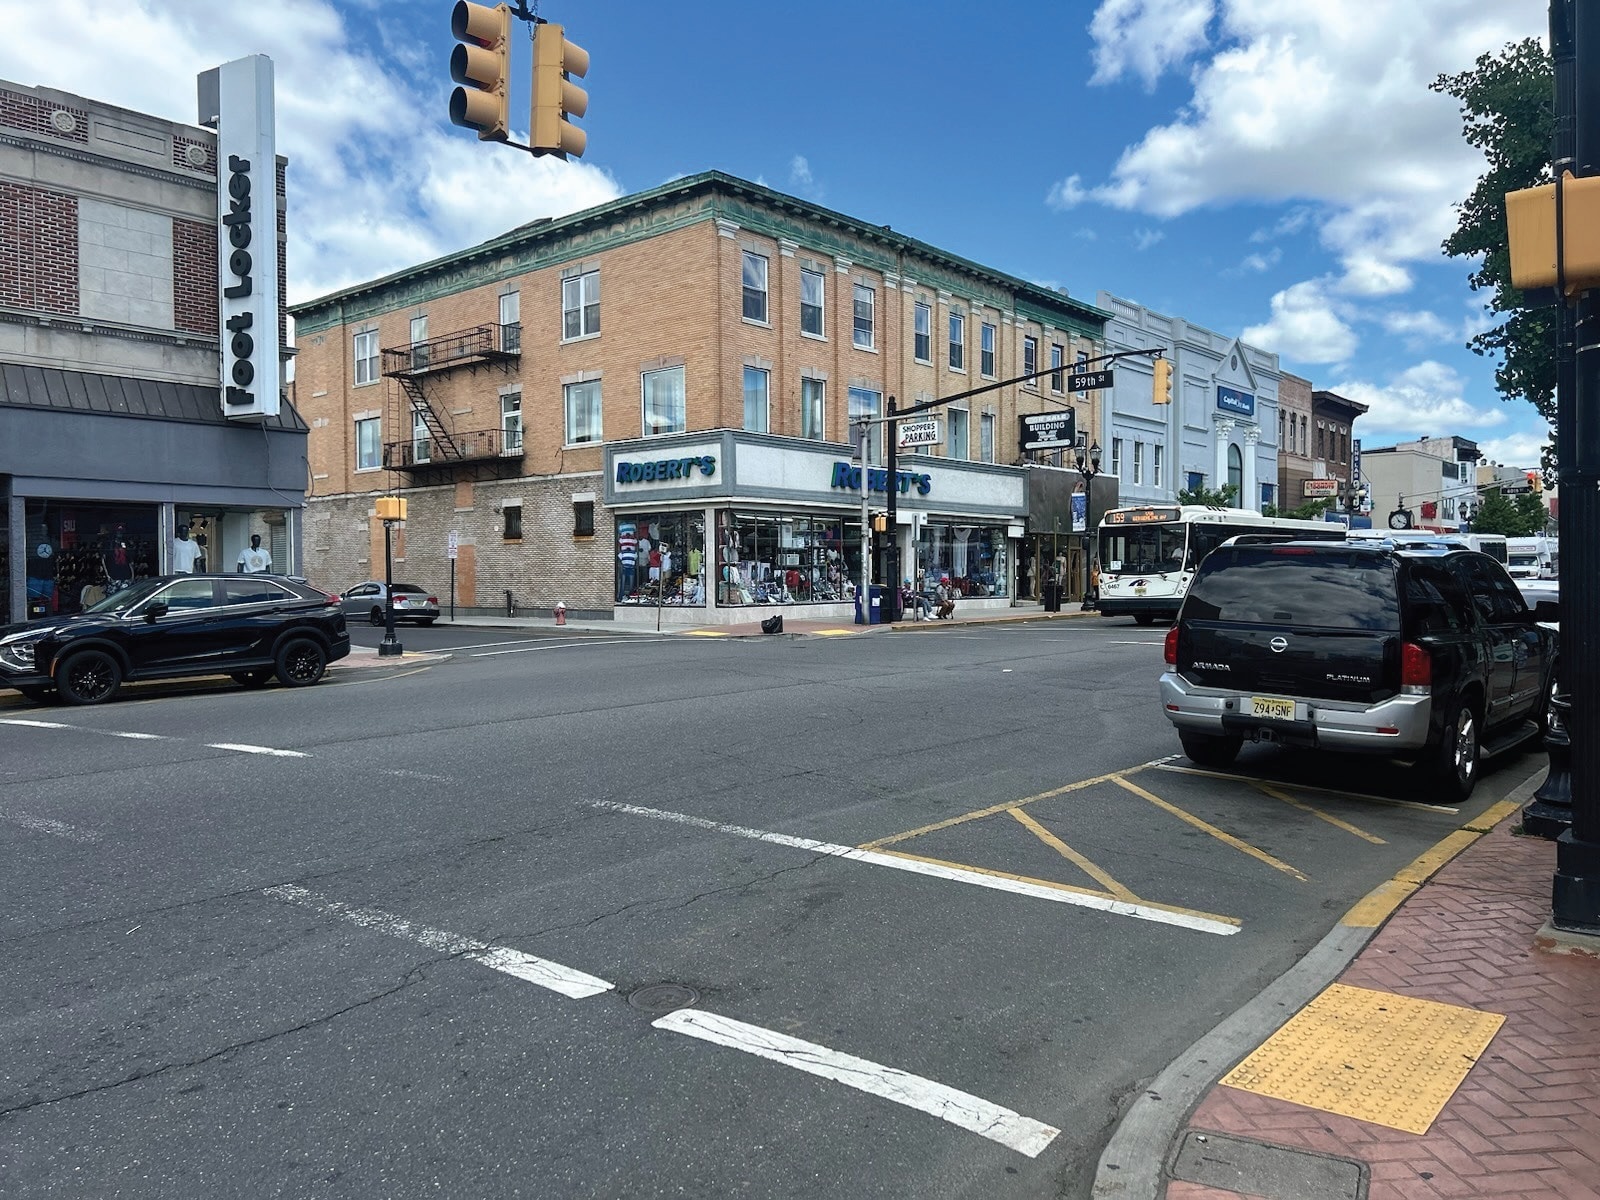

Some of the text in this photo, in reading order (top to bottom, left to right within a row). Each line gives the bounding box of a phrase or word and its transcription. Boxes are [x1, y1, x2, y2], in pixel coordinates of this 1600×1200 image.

[223, 155, 254, 405] Foot Locker
[1075, 376, 1096, 389] 59th
[902, 422, 936, 433] SHOPPERS
[1030, 422, 1065, 431] BUILDING
[905, 431, 936, 443] PARKING
[616, 456, 716, 483] ROBERT'S
[1112, 512, 1125, 523] 159
[1191, 661, 1231, 672] ARMADA
[1326, 673, 1371, 683] PLATINUM
